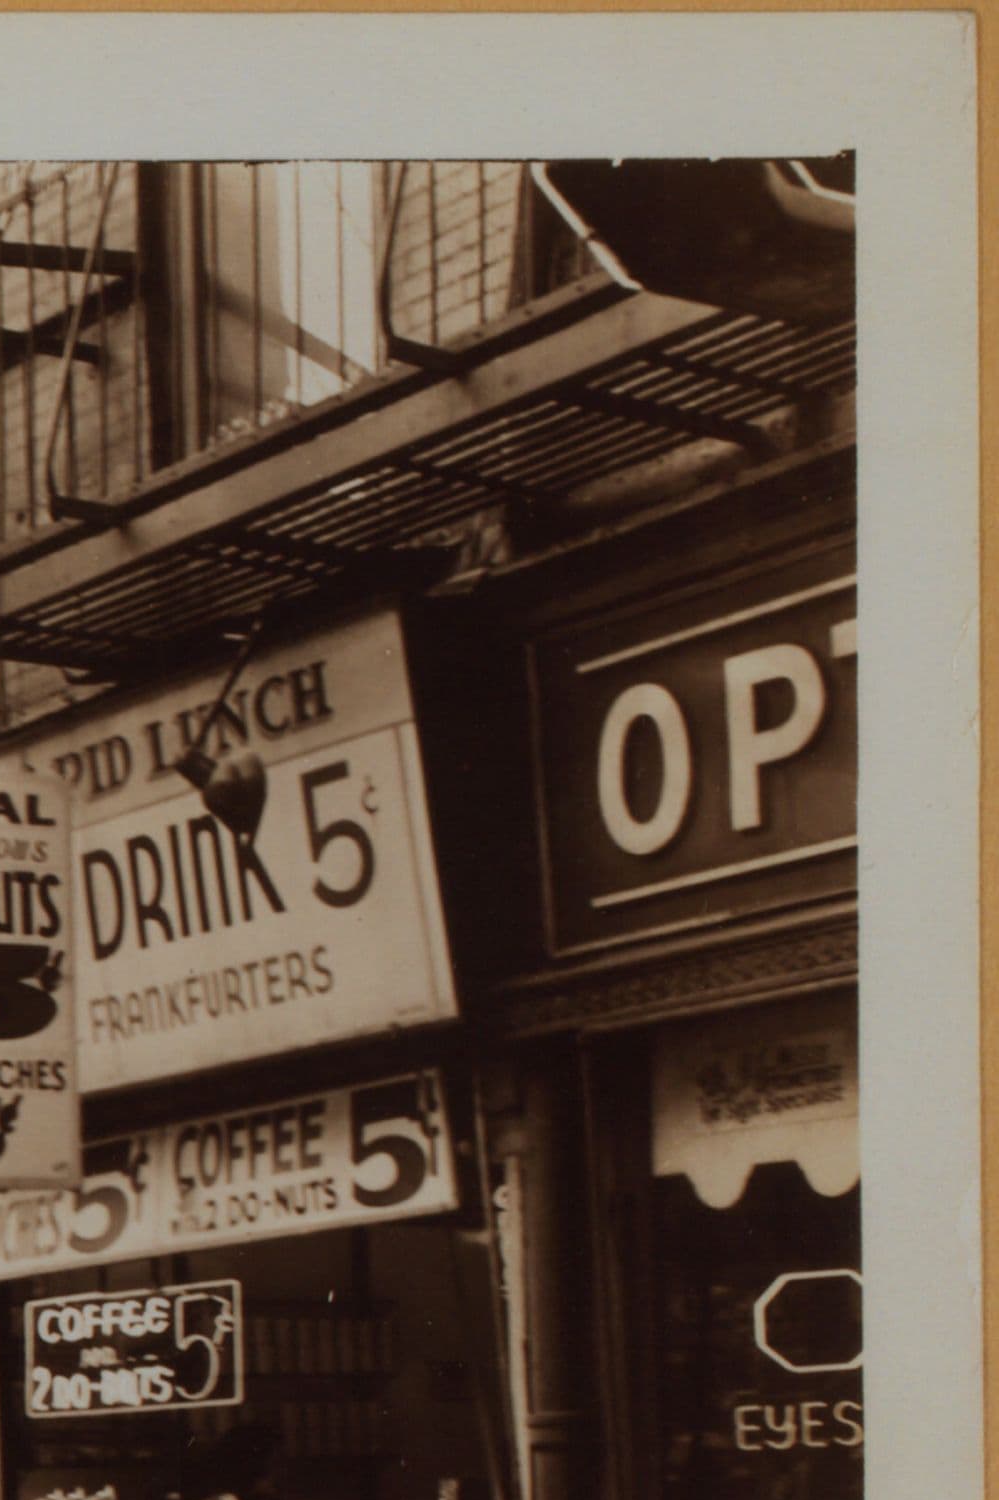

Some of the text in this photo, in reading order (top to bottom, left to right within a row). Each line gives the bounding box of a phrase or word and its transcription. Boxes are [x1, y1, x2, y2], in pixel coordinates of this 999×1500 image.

[52, 660, 334, 805] PID LUNCH
[79, 814, 287, 963] DRINK
[88, 943, 335, 1044] FRANKFURTERS
[173, 1097, 327, 1198] COFFEE
[203, 1197, 221, 1232] 2
[38, 1297, 172, 1345] COFFEE
[31, 1366, 51, 1411] 2
[734, 1402, 863, 1450] EYES
